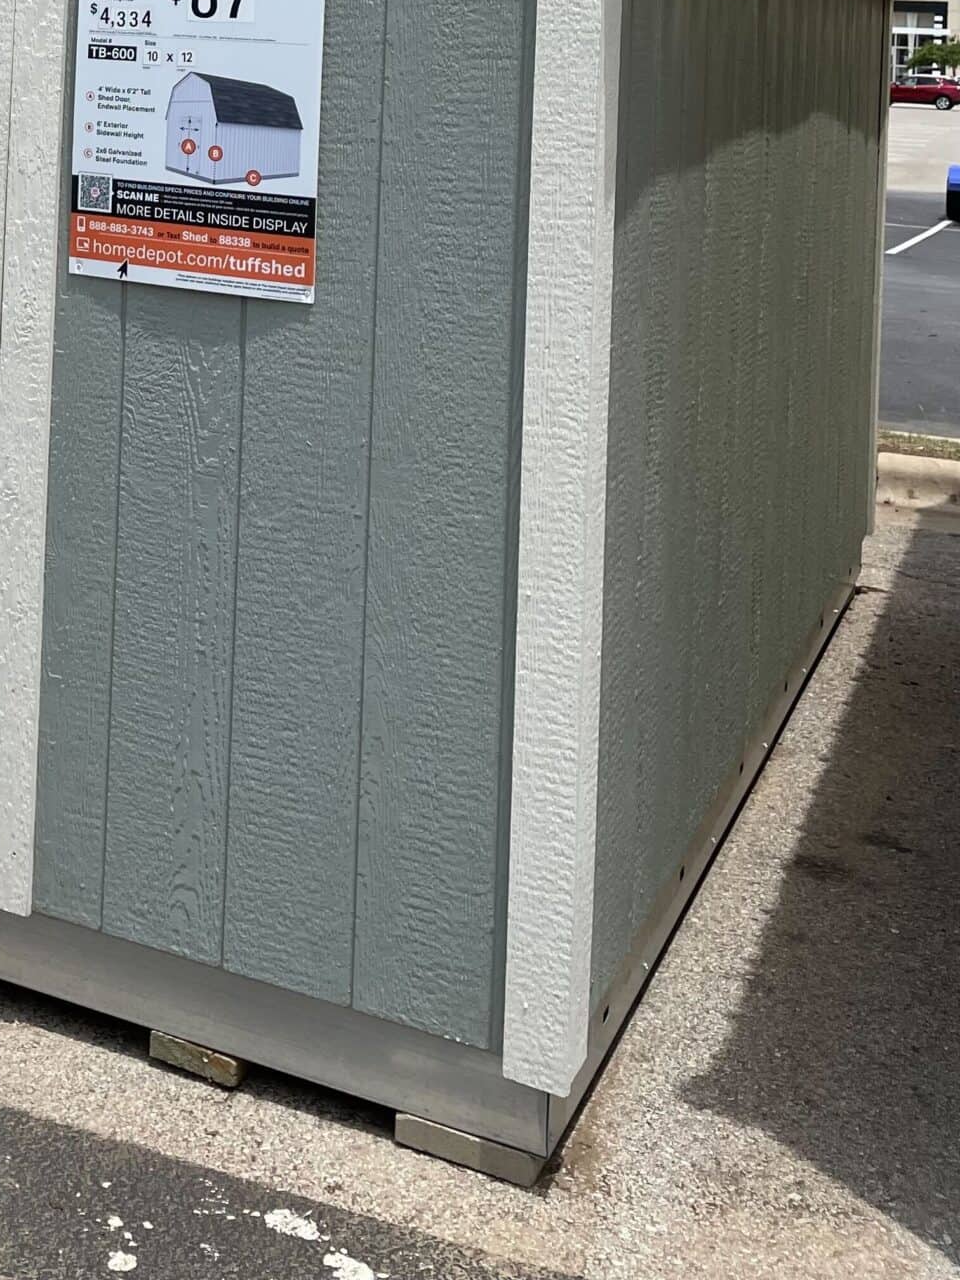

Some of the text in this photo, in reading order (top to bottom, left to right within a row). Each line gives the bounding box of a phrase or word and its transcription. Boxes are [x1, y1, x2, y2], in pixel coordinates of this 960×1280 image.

[90, 46, 135, 60] TB-600
[147, 51, 158, 62] 10
[182, 52, 193, 62] 12
[185, 143, 192, 151] A
[213, 149, 219, 157] B
[113, 157, 148, 166] Foundation
[250, 174, 257, 182] C
[117, 190, 143, 201] SCAN
[145, 193, 160, 202] ME
[215, 192, 246, 200] CONFIGURE
[263, 196, 287, 204] BUILDING
[288, 198, 309, 206] ONLINE
[116, 203, 152, 217] MORE
[154, 207, 204, 223] DETAILS
[208, 213, 249, 228] INSIDE
[253, 217, 308, 234] DISPLAY
[89, 220, 154, 236] 888-883-3743
[166, 231, 180, 239] Text
[182, 231, 208, 243] Shed
[219, 235, 251, 247] 88338
[262, 242, 280, 250] build
[288, 245, 309, 254] quote
[93, 239, 305, 278] homedepot.com/tuffshed
